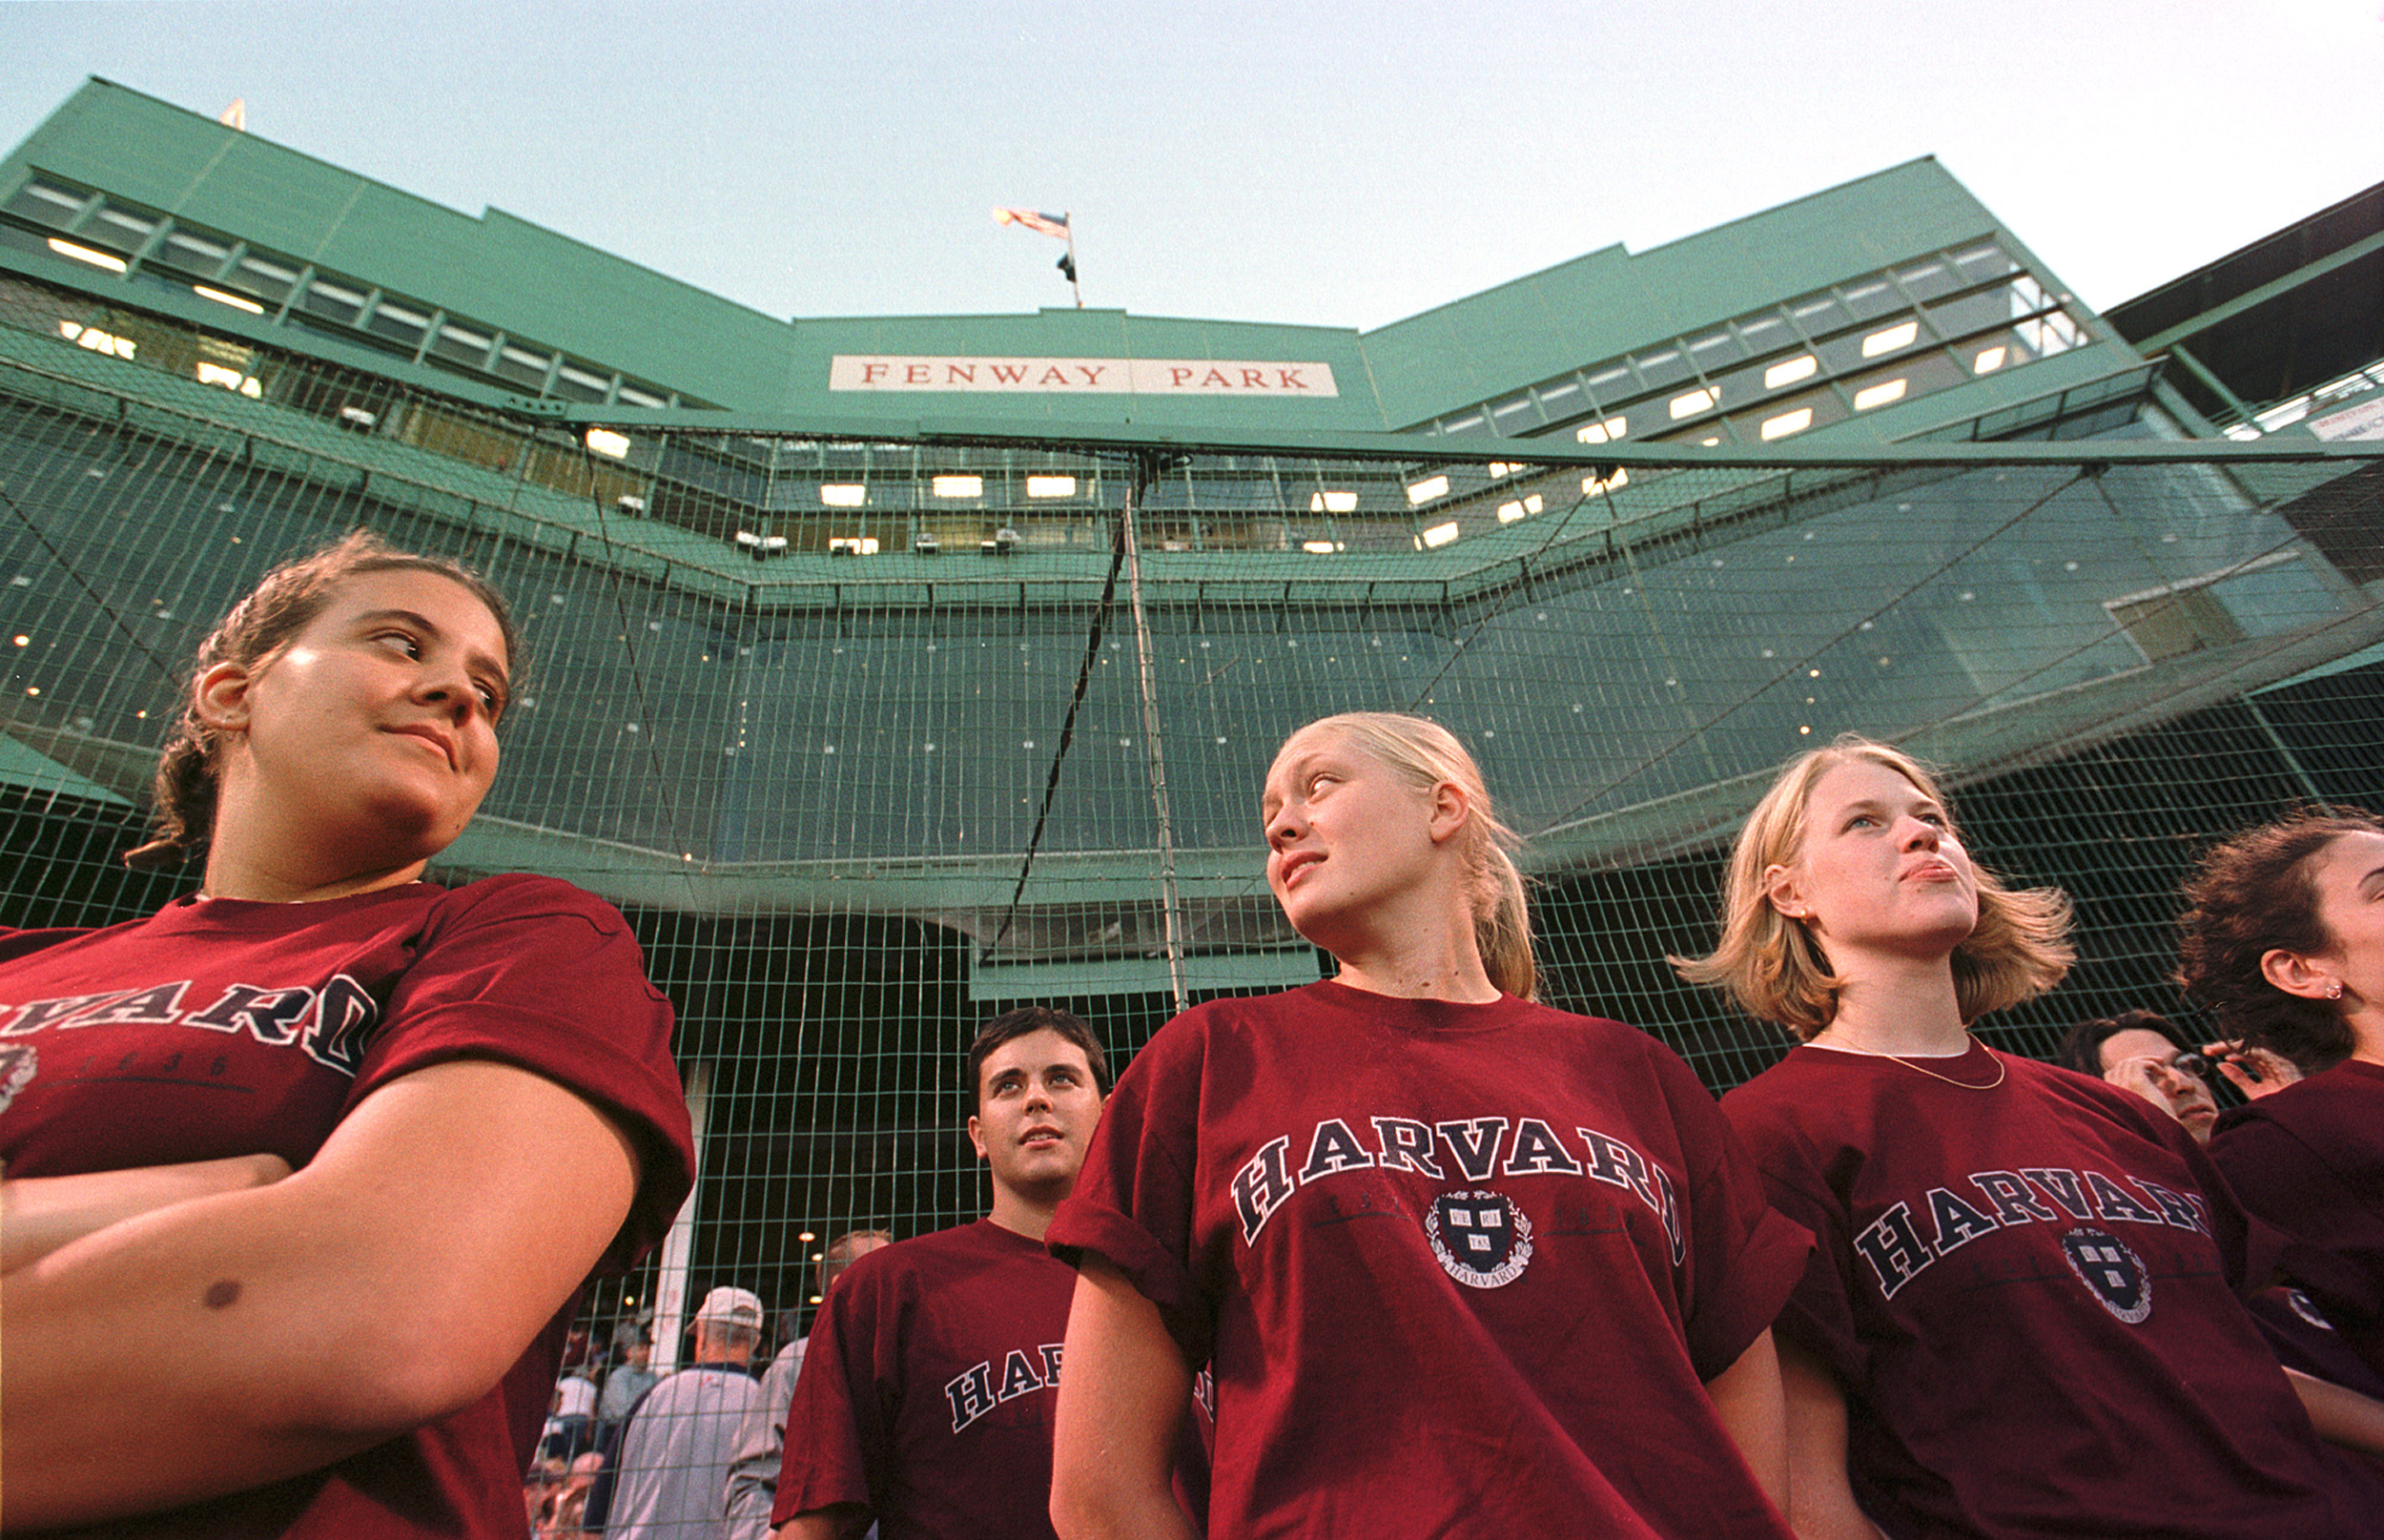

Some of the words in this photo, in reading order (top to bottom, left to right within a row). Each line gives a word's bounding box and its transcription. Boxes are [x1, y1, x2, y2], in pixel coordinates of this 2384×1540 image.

[861, 363, 1106, 385] FENWAY
[1170, 367, 1309, 389] PARK
[0, 974, 379, 1078] VARD
[1231, 1116, 1687, 1267] HARVARD
[1449, 1264, 1518, 1287] HARVARD
